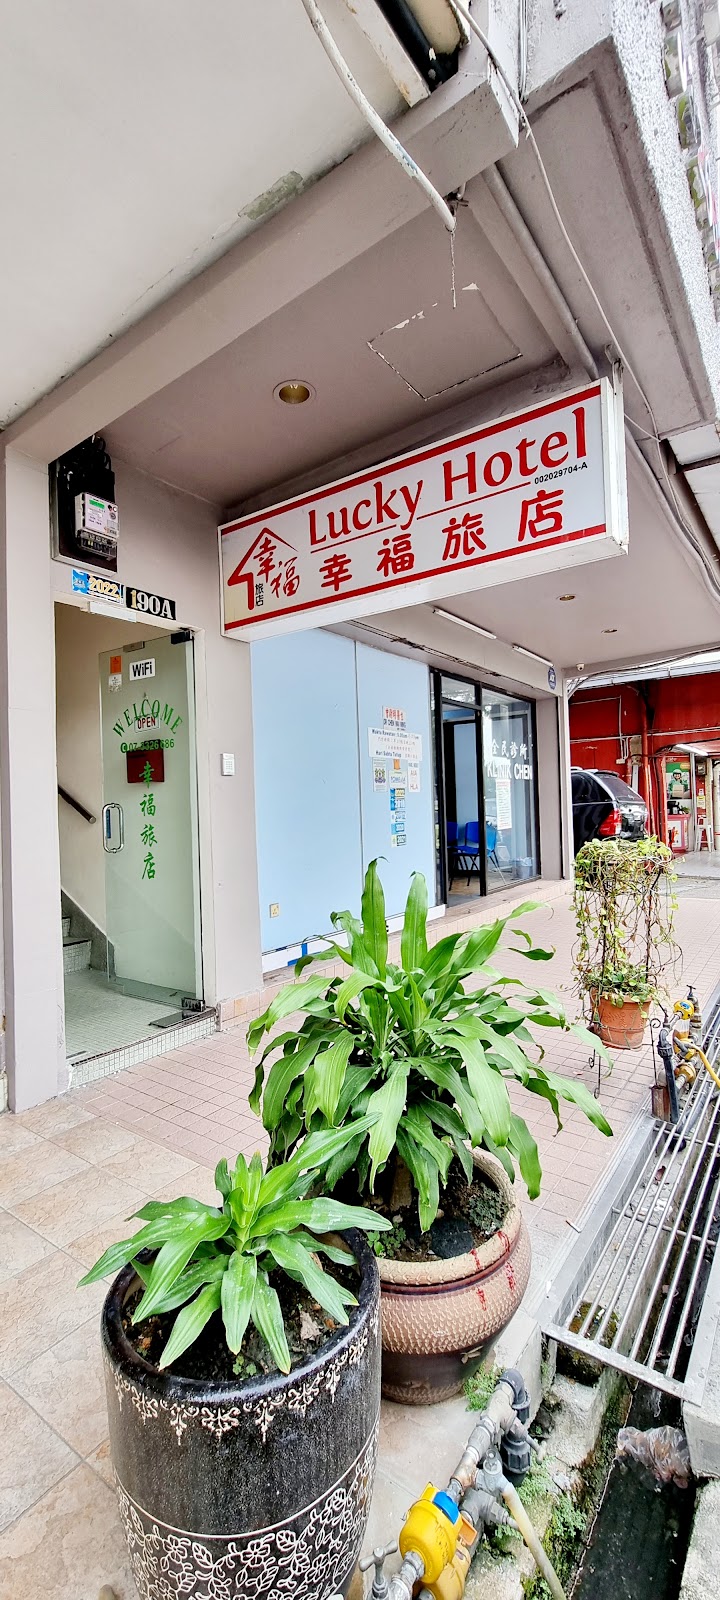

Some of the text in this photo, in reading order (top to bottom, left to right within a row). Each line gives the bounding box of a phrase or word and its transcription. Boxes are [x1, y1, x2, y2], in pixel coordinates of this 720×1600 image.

[309, 406, 587, 545] Lucky Hotel
[534, 461, 588, 484] 002029704-A
[318, 489, 564, 592] 幸福旅店
[253, 536, 300, 599] 幸福
[88, 575, 120, 598] 2022
[254, 582, 265, 607] 旅店
[130, 589, 174, 620] 190A
[132, 661, 153, 678] WiFi
[112, 698, 184, 738] WELCOME
[137, 715, 156, 730] OPEN
[487, 762, 533, 780] KLINIK CHEN
[138, 760, 158, 880] 幸福旅店
